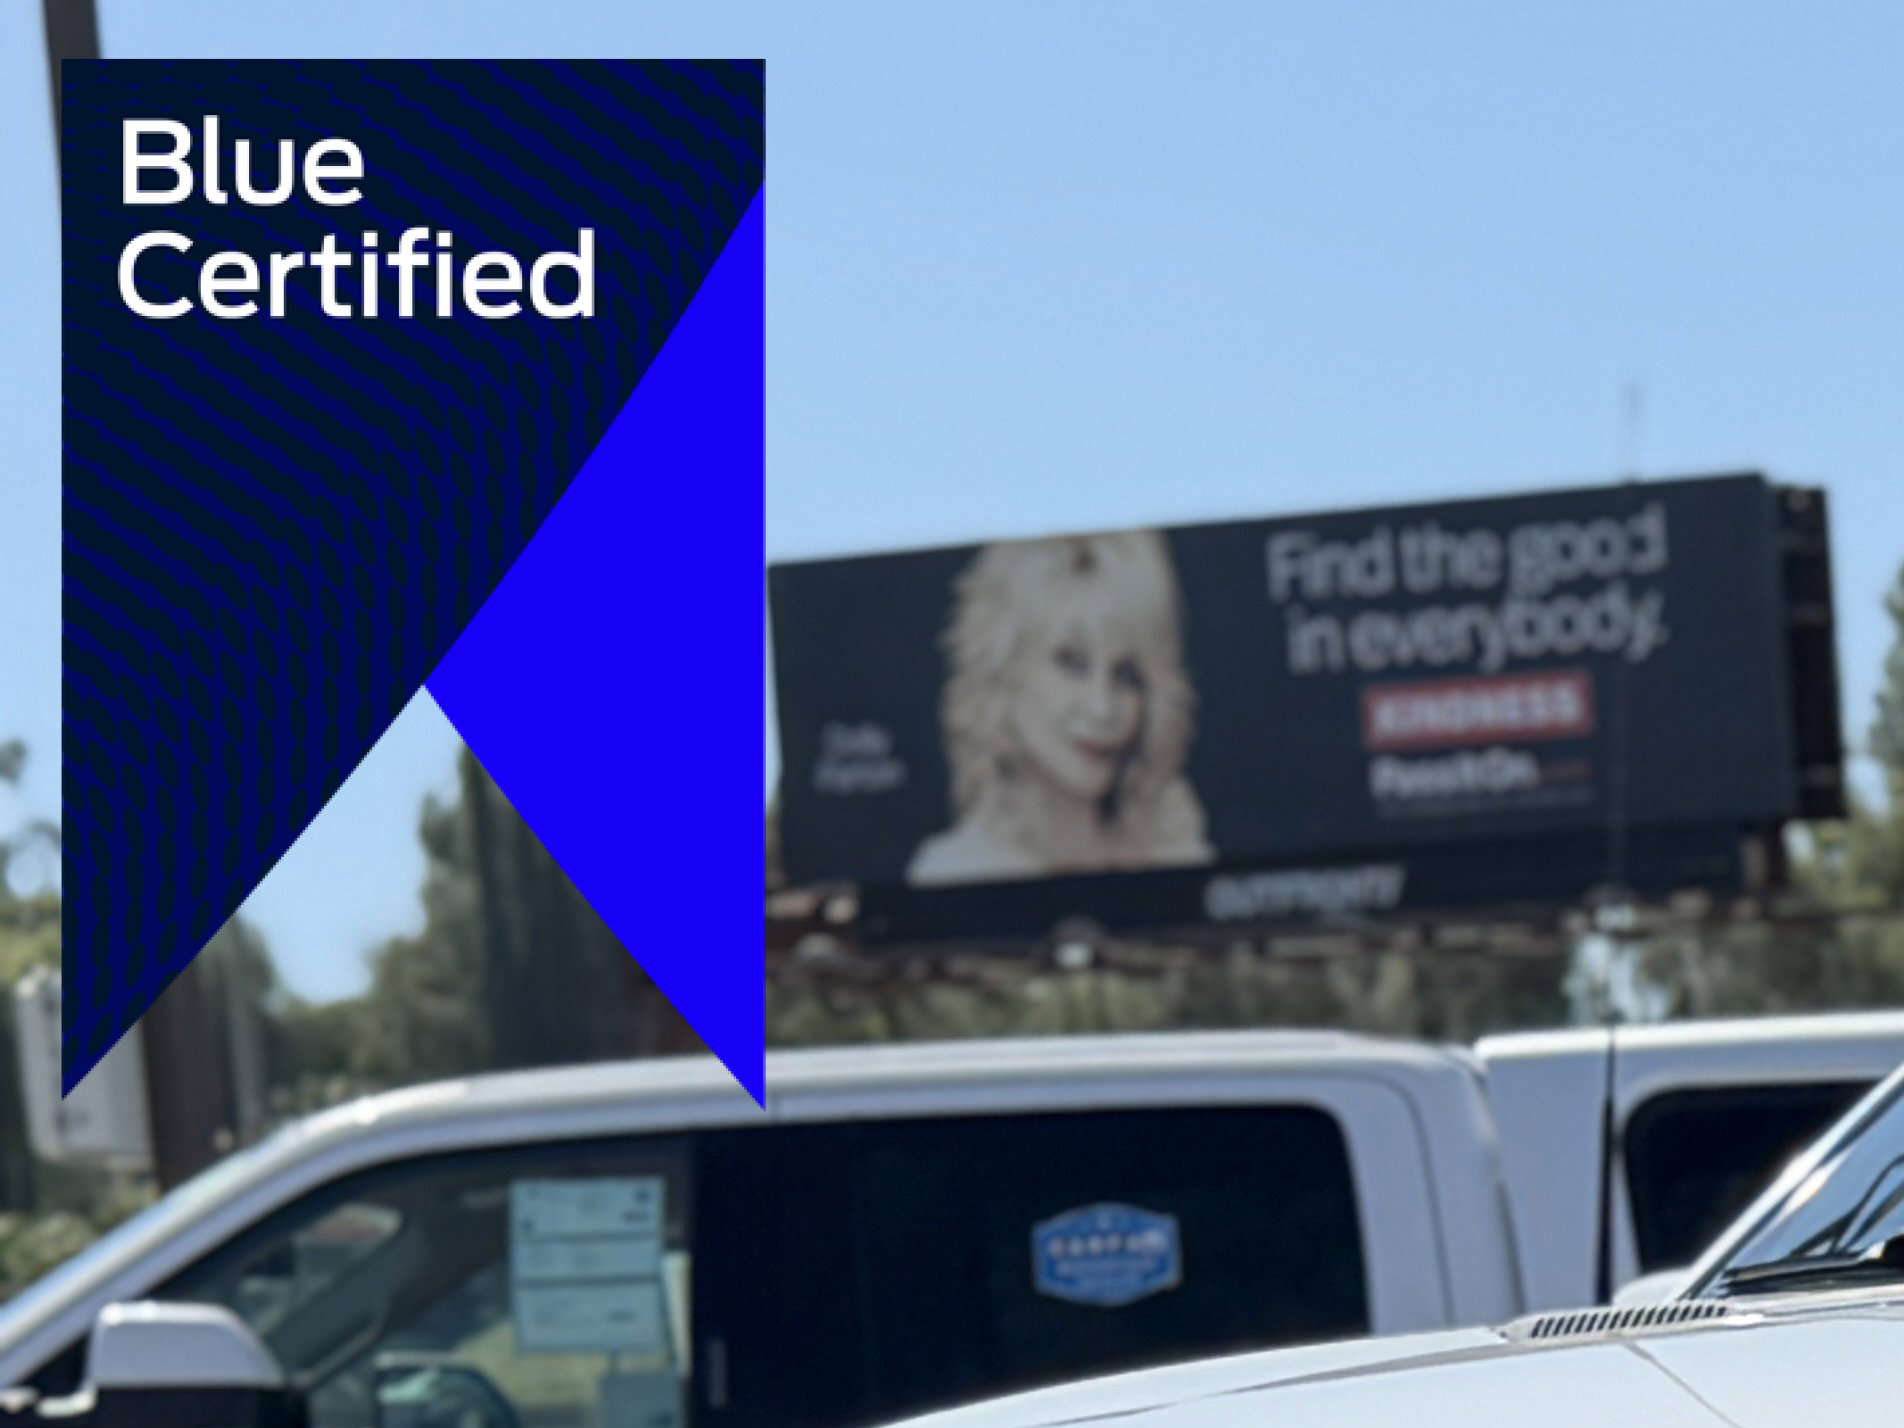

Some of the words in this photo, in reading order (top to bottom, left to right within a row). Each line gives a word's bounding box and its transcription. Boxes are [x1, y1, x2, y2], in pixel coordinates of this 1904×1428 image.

[1268, 528, 1392, 599] Find
[1400, 524, 1499, 590] the
[1511, 505, 1666, 592] good
[1290, 610, 1343, 672] in
